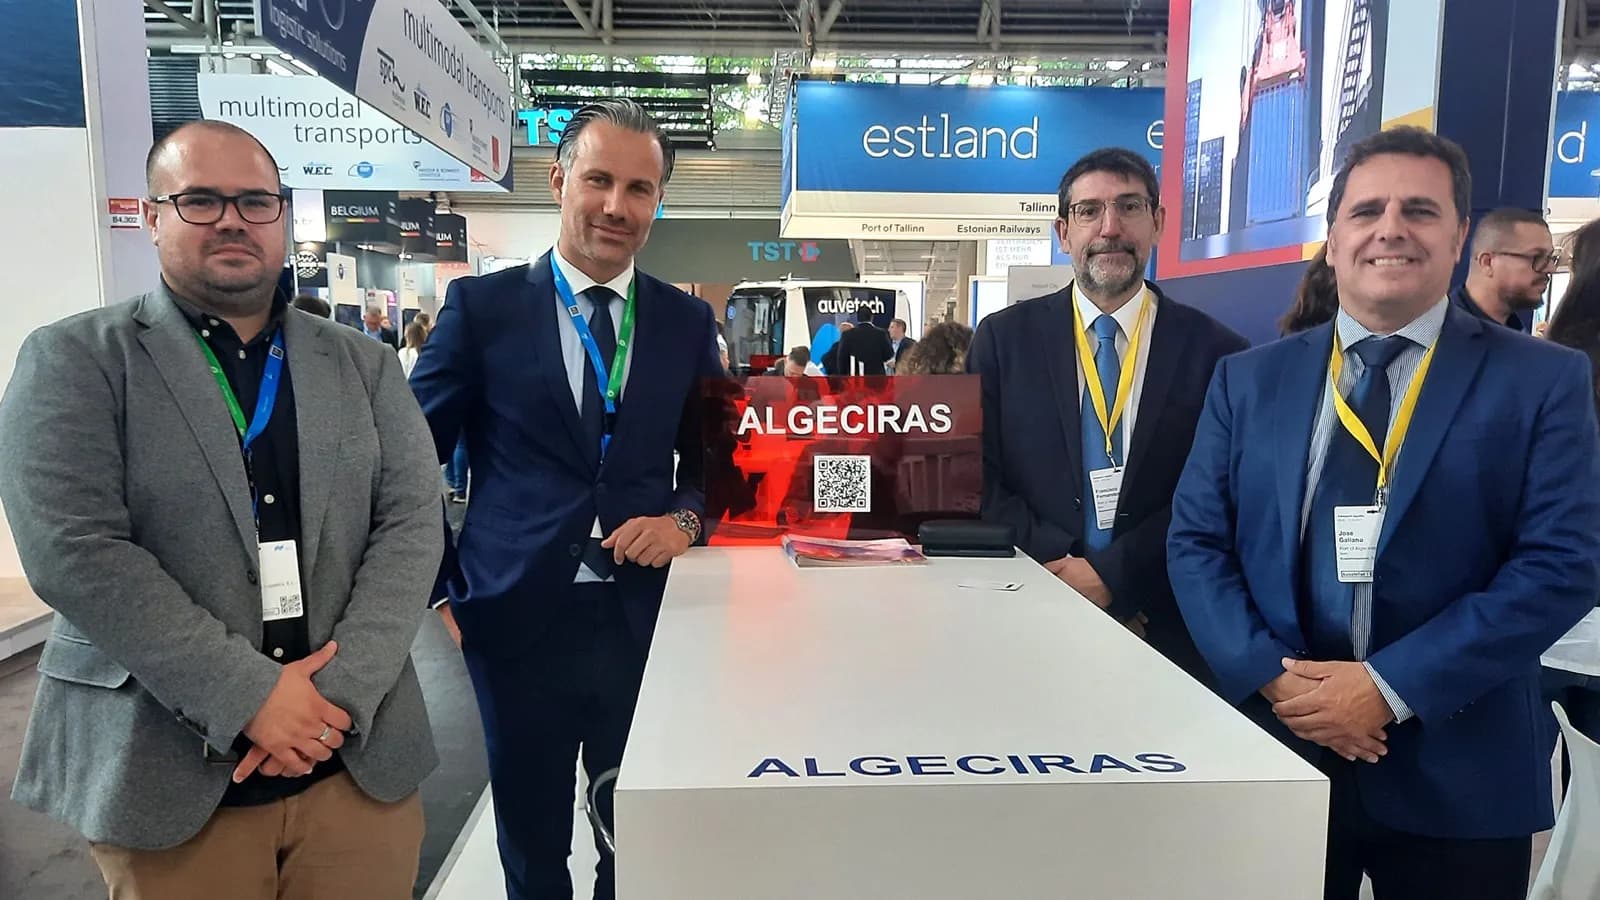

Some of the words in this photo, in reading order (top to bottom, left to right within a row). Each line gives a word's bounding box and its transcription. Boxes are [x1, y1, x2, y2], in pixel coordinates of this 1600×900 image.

[404, 7, 464, 87] multimodal
[466, 64, 505, 123] transports
[219, 95, 361, 118] multimodal
[294, 123, 423, 150] transports
[518, 108, 574, 146] TS
[863, 112, 1039, 160] estland
[330, 206, 380, 217] BELGIUM
[1019, 202, 1056, 213] Tallinn
[862, 224, 883, 233] Port
[885, 224, 892, 233] of
[894, 224, 925, 233] Tallinn
[957, 225, 998, 234] Estonian
[1000, 225, 1041, 235] Railways
[747, 241, 796, 261] TST
[817, 295, 885, 314] auvetch
[736, 403, 953, 436] ALGECIRAS
[747, 752, 1188, 779] ALGECIRAS
